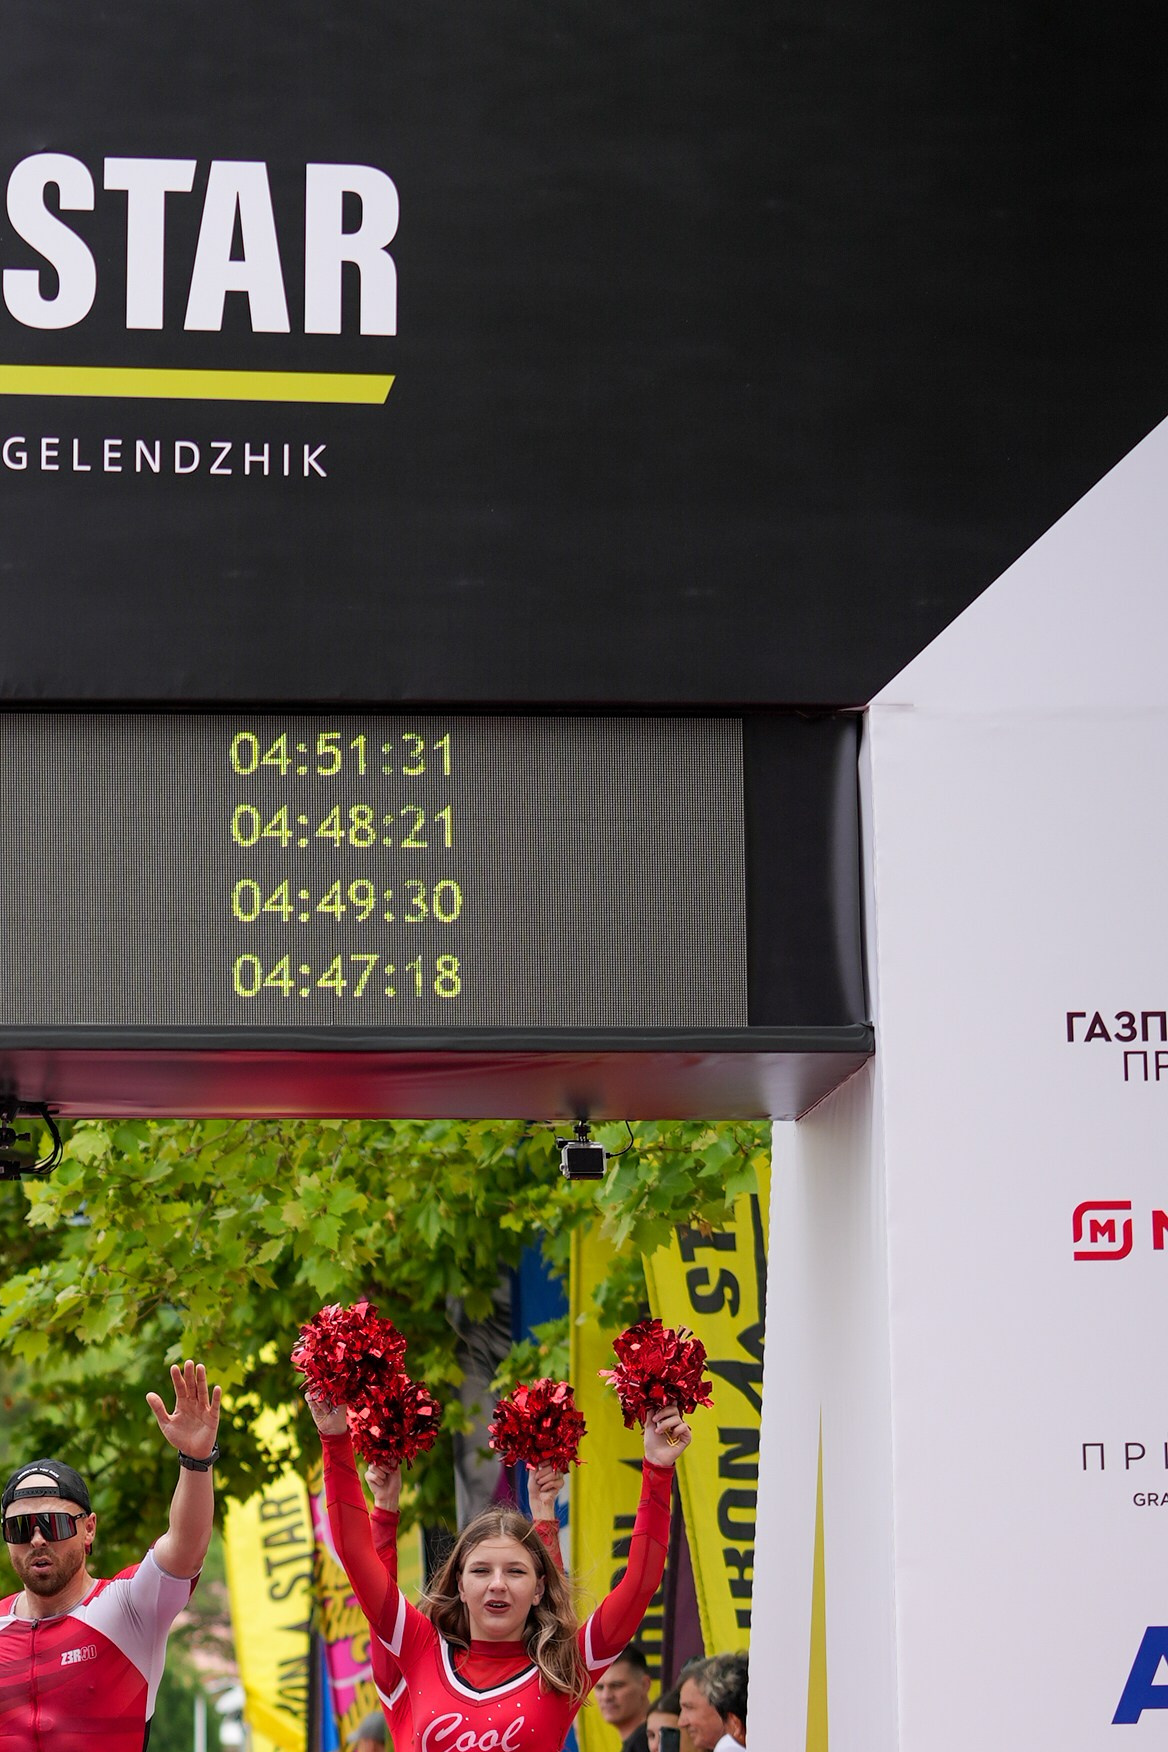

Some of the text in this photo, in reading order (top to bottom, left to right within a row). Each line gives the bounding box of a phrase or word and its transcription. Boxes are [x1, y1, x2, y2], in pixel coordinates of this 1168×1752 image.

[2, 153, 399, 336] STAR
[2, 436, 328, 478] GELENDZHIK
[230, 732, 452, 775] 04:51:31
[231, 804, 454, 848] 04:48:21
[231, 878, 463, 923] 04:49:30
[233, 953, 462, 998] 04:47:18
[1082, 1442, 1168, 1471] ПР
[259, 1494, 314, 1604] STAR
